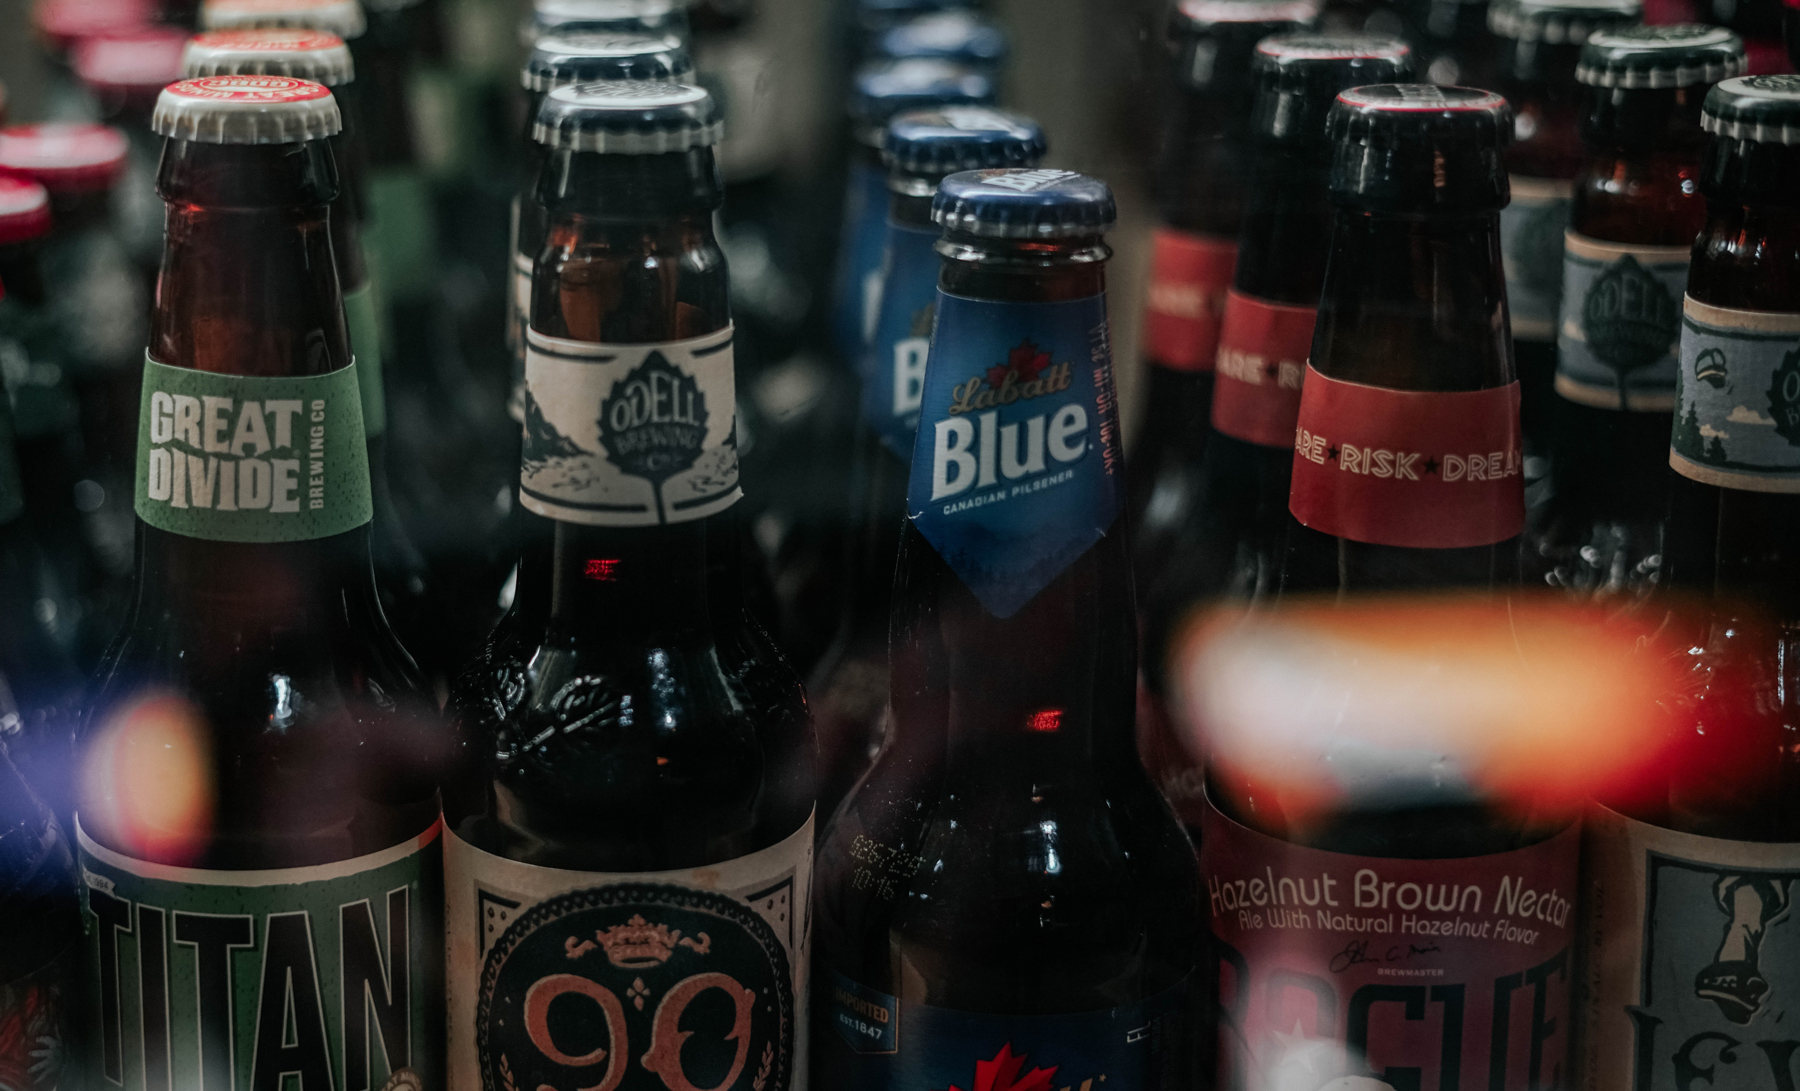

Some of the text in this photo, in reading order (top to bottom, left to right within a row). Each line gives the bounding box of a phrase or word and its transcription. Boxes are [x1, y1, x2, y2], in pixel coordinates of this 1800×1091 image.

[609, 369, 700, 432] ODELL
[949, 361, 1072, 416] Labatt
[150, 390, 303, 456] GREAT
[309, 399, 326, 510] BREWING CO
[613, 424, 699, 455] BREWING
[930, 403, 1088, 502] Blue
[148, 447, 301, 513] DIVIDE
[943, 469, 1075, 516] CANADIAN PILSENER
[1340, 443, 1420, 481] RISK
[1208, 865, 1572, 929] Hazelnut Brown Nectar
[1238, 907, 1540, 945] Ale With Natural Hazelnut Flavor
[88, 884, 411, 1091] TITAN
[1377, 967, 1445, 977] BREWMASTER
[524, 971, 756, 1091] 90
[836, 986, 889, 1024] IMPORTED
